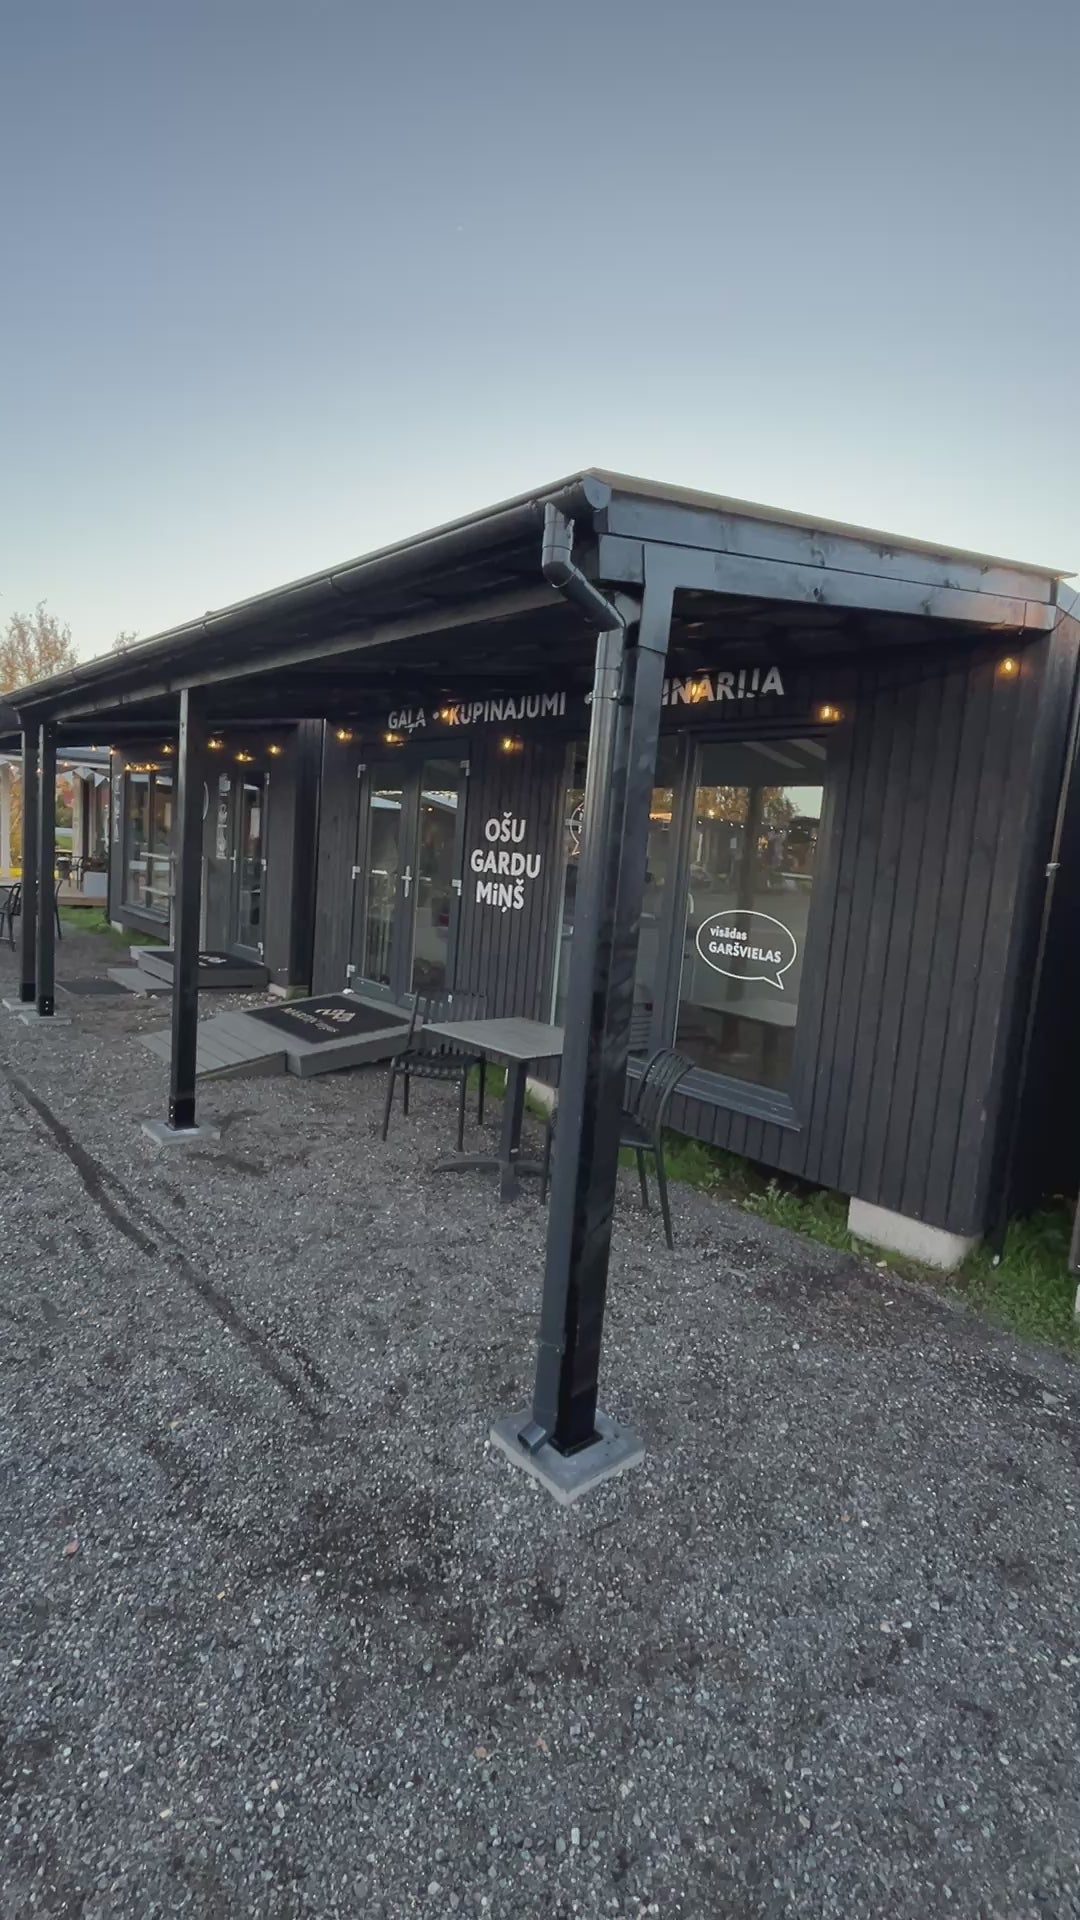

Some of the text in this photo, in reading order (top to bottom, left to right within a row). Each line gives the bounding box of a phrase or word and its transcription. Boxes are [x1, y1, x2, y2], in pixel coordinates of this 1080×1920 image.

[485, 811, 526, 842] OŠU
[471, 849, 541, 878] GARDU
[708, 942, 782, 963] GARŠVIELAS
